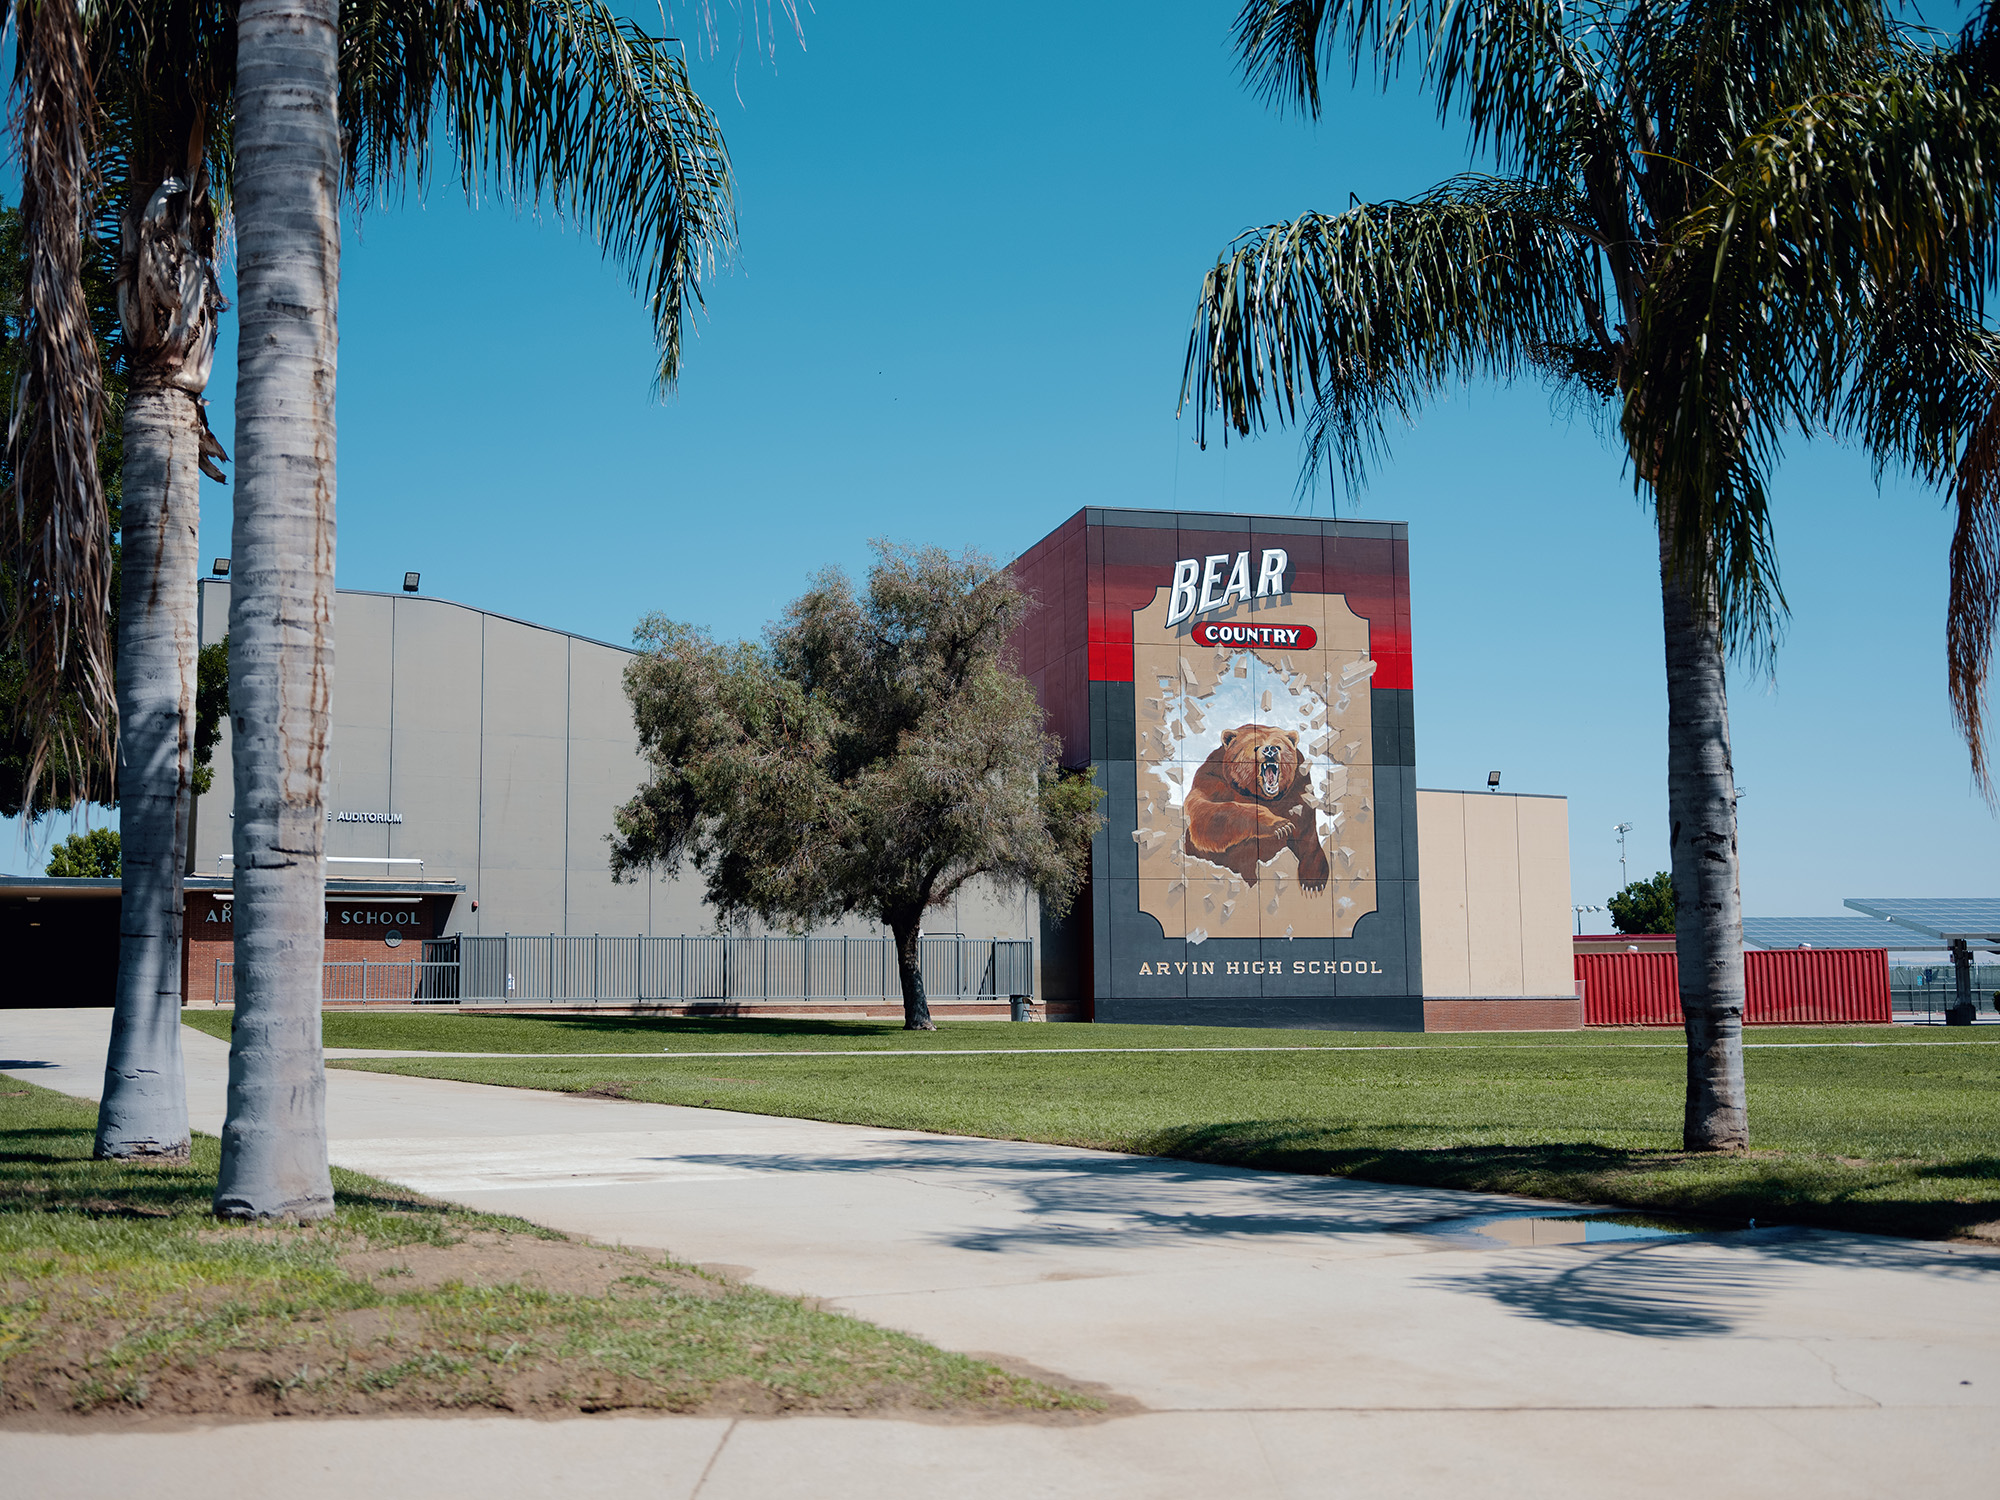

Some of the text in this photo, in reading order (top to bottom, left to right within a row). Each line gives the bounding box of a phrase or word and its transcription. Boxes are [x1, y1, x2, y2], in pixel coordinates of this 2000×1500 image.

[1165, 548, 1288, 629] BEAR
[1205, 625, 1300, 644] COUNTRY
[338, 811, 403, 824] AUDITORIUM
[340, 911, 421, 925] SCHOOL
[1138, 960, 1383, 975] ARVIN HIGH SCHOOL
